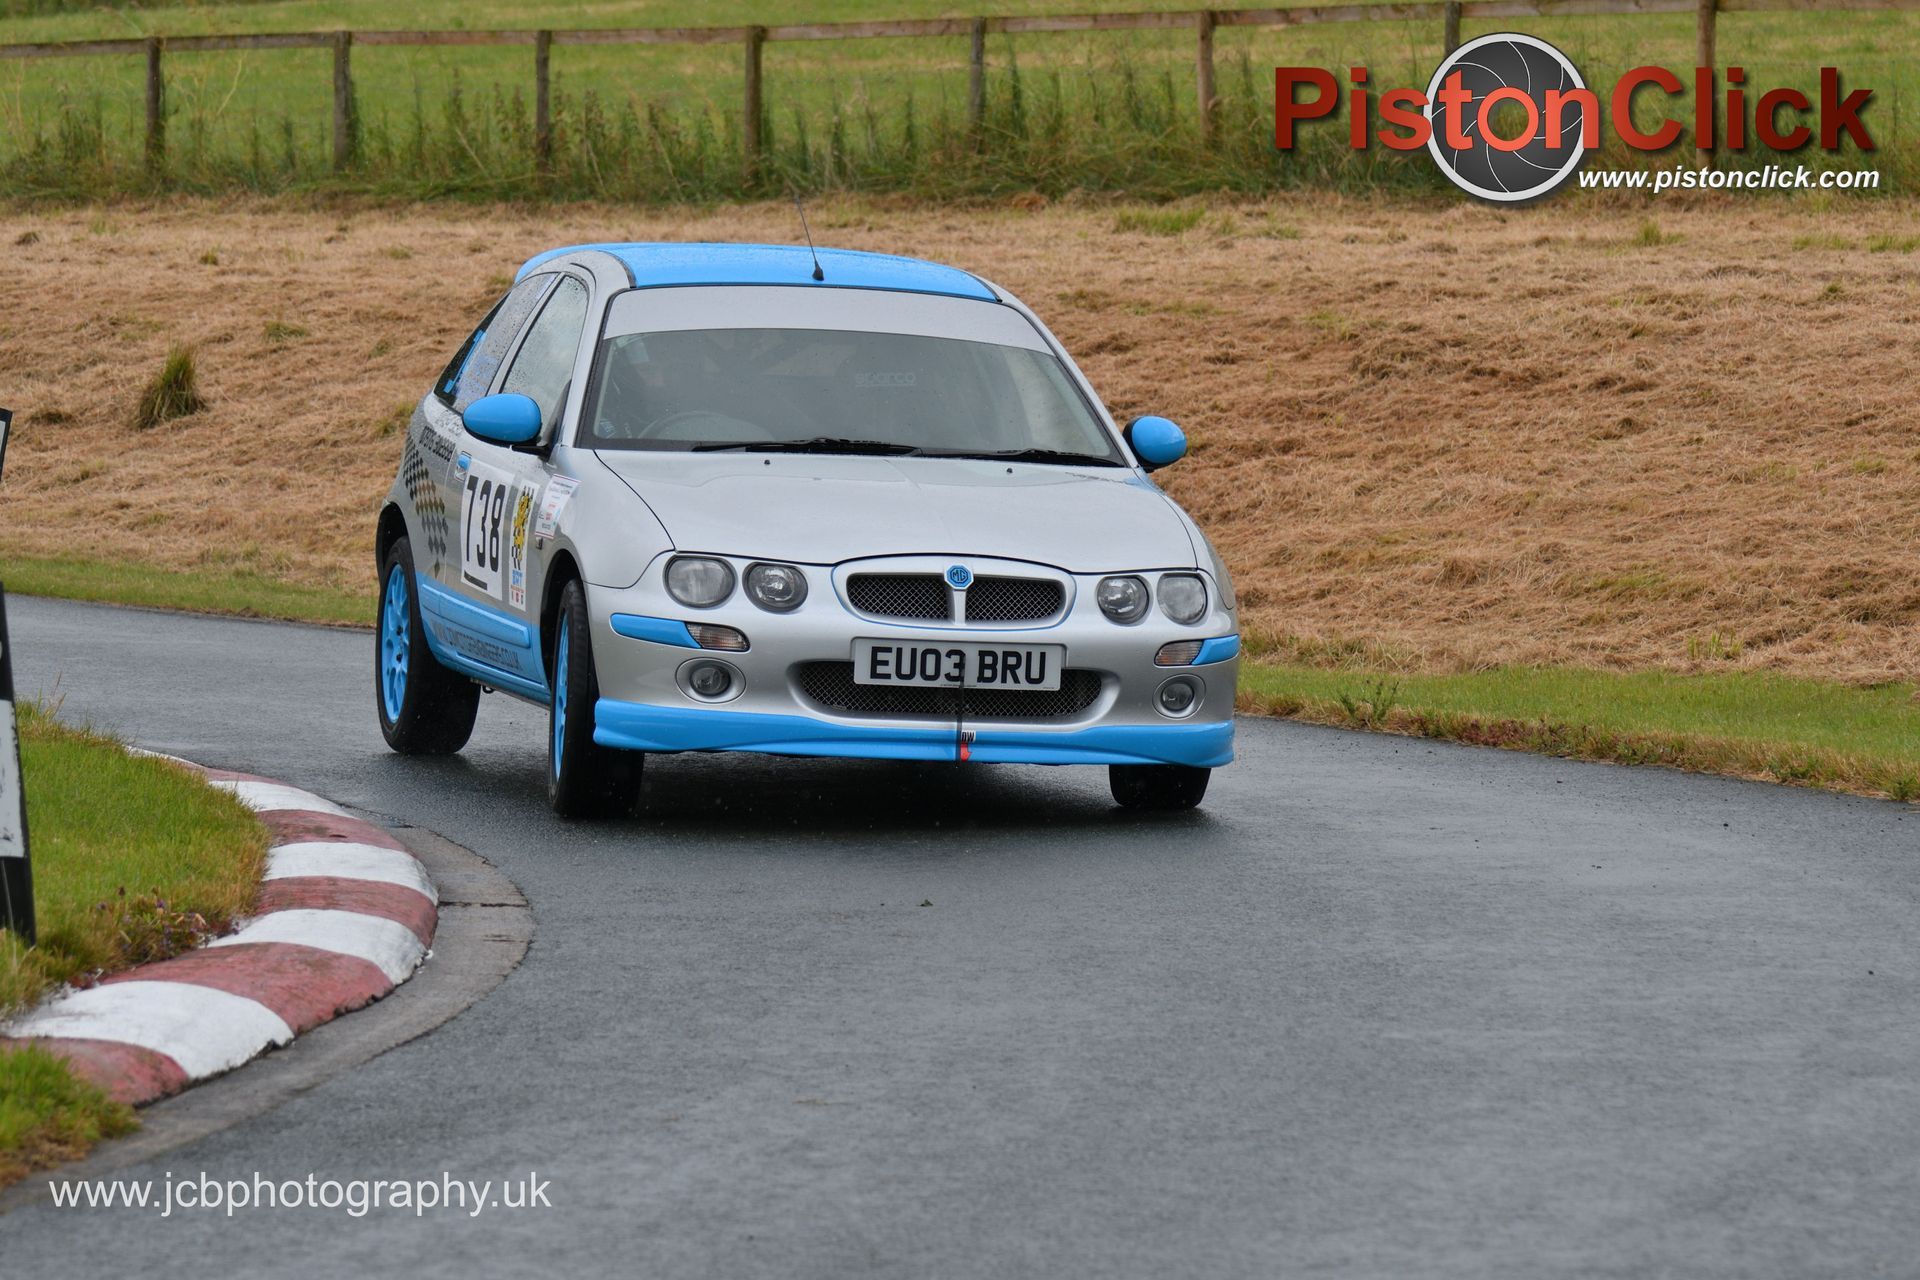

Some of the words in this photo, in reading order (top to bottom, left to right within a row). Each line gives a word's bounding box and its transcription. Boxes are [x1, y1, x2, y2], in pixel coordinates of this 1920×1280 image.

[468, 474, 507, 572] 738
[950, 569, 968, 582] MG
[870, 646, 965, 681] EU03
[977, 649, 1047, 684] BRU
